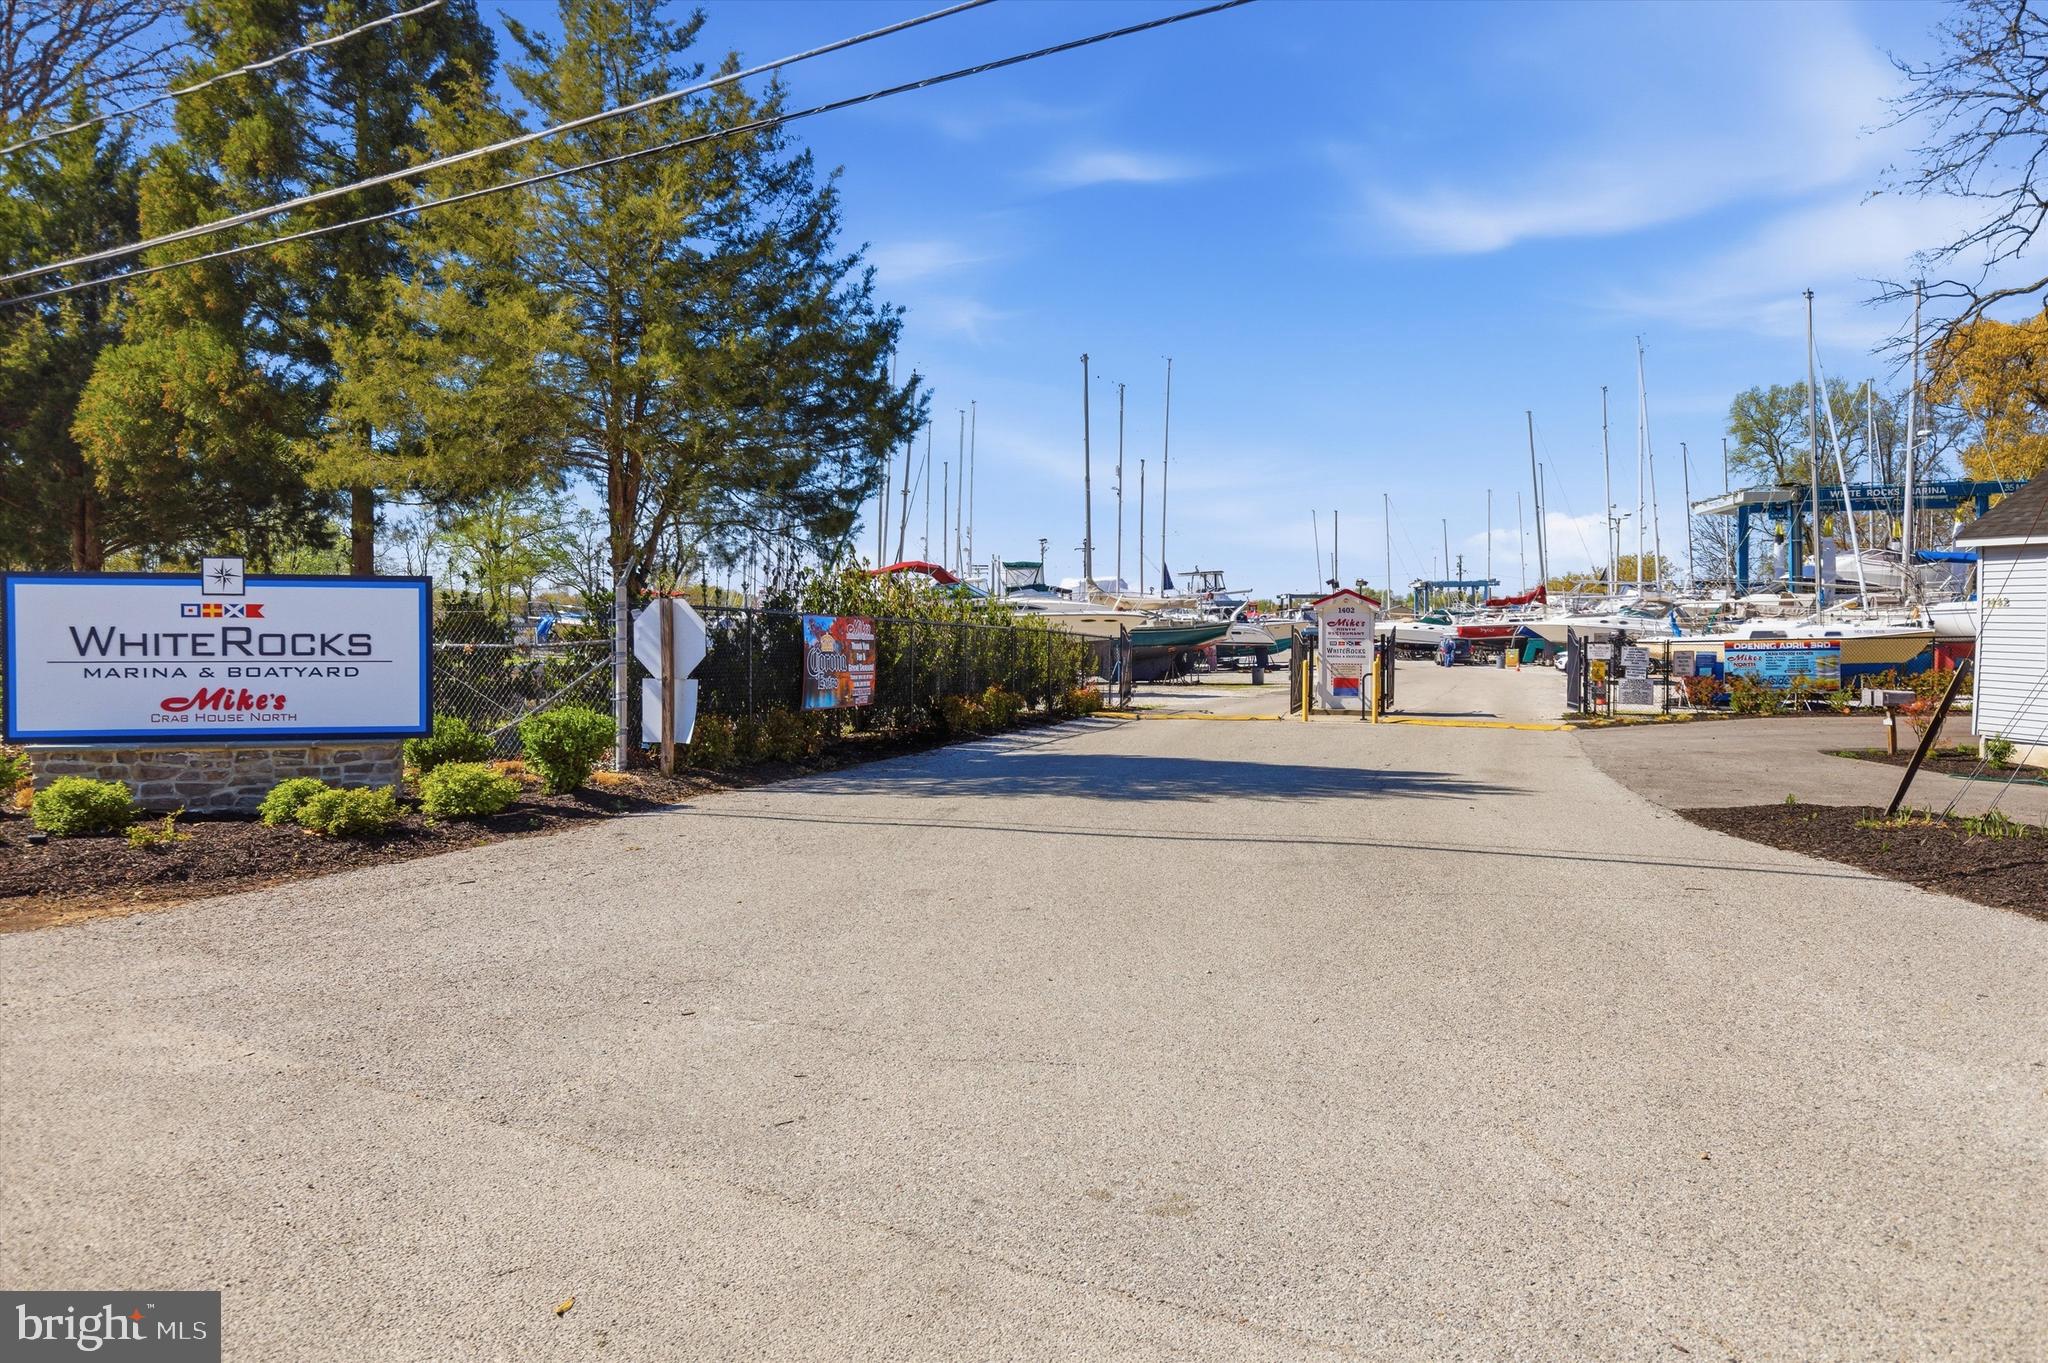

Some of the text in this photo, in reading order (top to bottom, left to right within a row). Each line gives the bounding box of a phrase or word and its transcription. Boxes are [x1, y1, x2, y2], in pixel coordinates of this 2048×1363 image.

[1866, 488, 1900, 496] ROCKS
[1912, 486, 1946, 495] ARINA
[1327, 618, 1366, 627] Mike's
[1733, 642, 1777, 650] OPENING
[807, 647, 848, 677] Corona
[83, 666, 359, 679] MARINA & BOATYARD
[160, 687, 287, 712] Mike's
